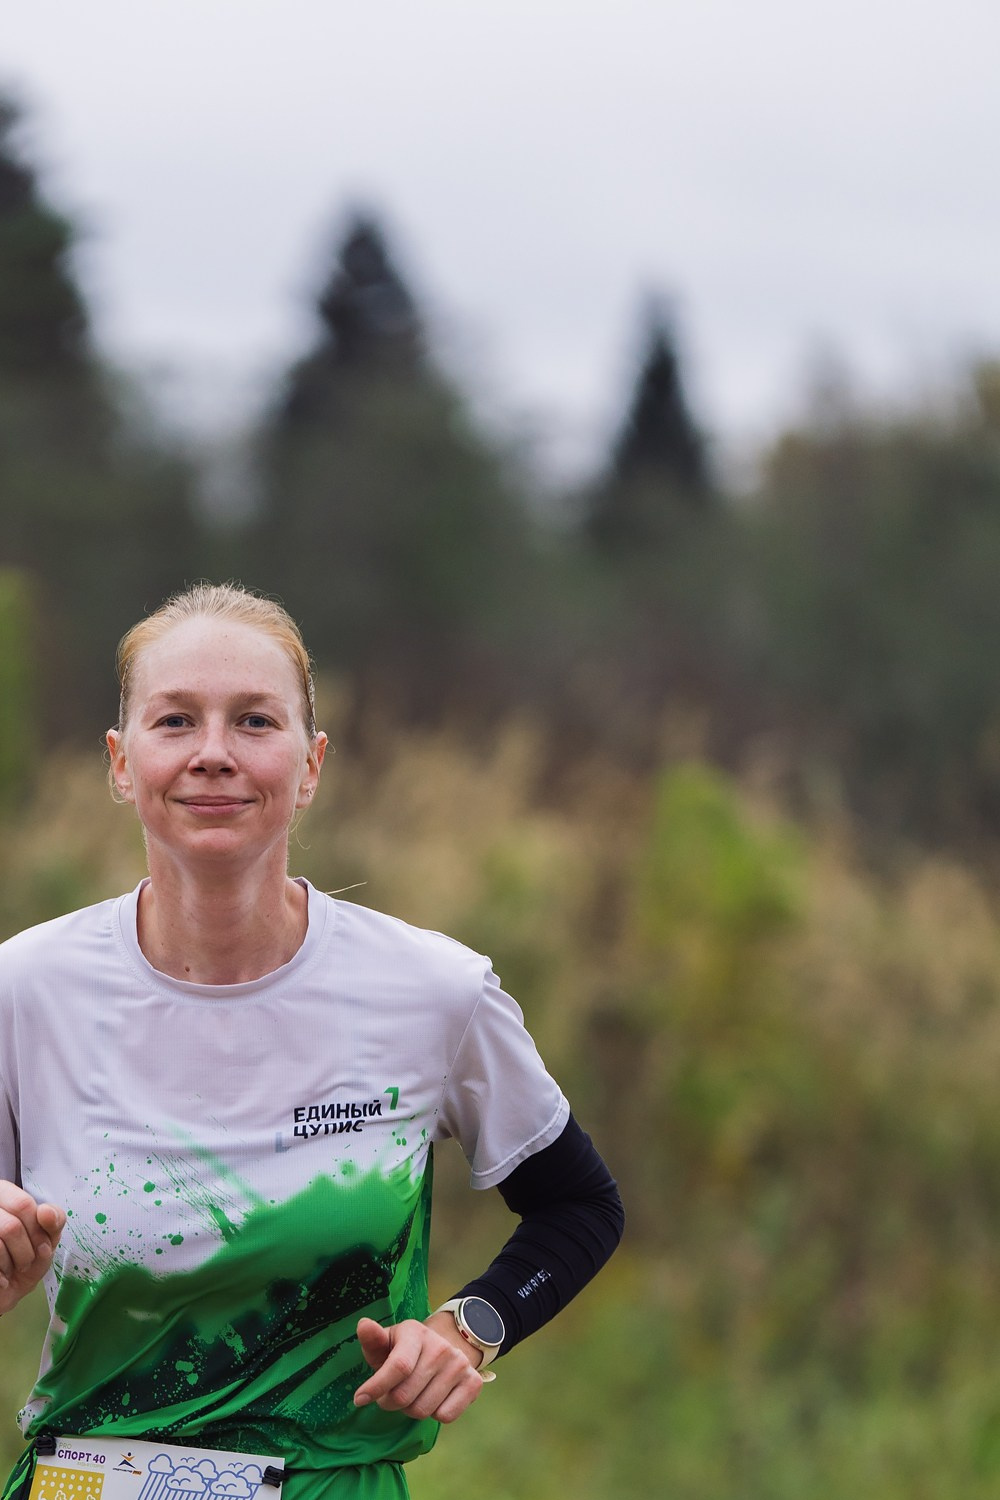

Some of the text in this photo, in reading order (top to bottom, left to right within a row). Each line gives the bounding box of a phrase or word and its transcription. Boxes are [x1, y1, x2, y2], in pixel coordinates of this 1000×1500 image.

[294, 1100, 382, 1123] ЕДИНЫЙ
[294, 1119, 366, 1139] ЦУПИС
[57, 1449, 106, 1464] СПОРТ 40
